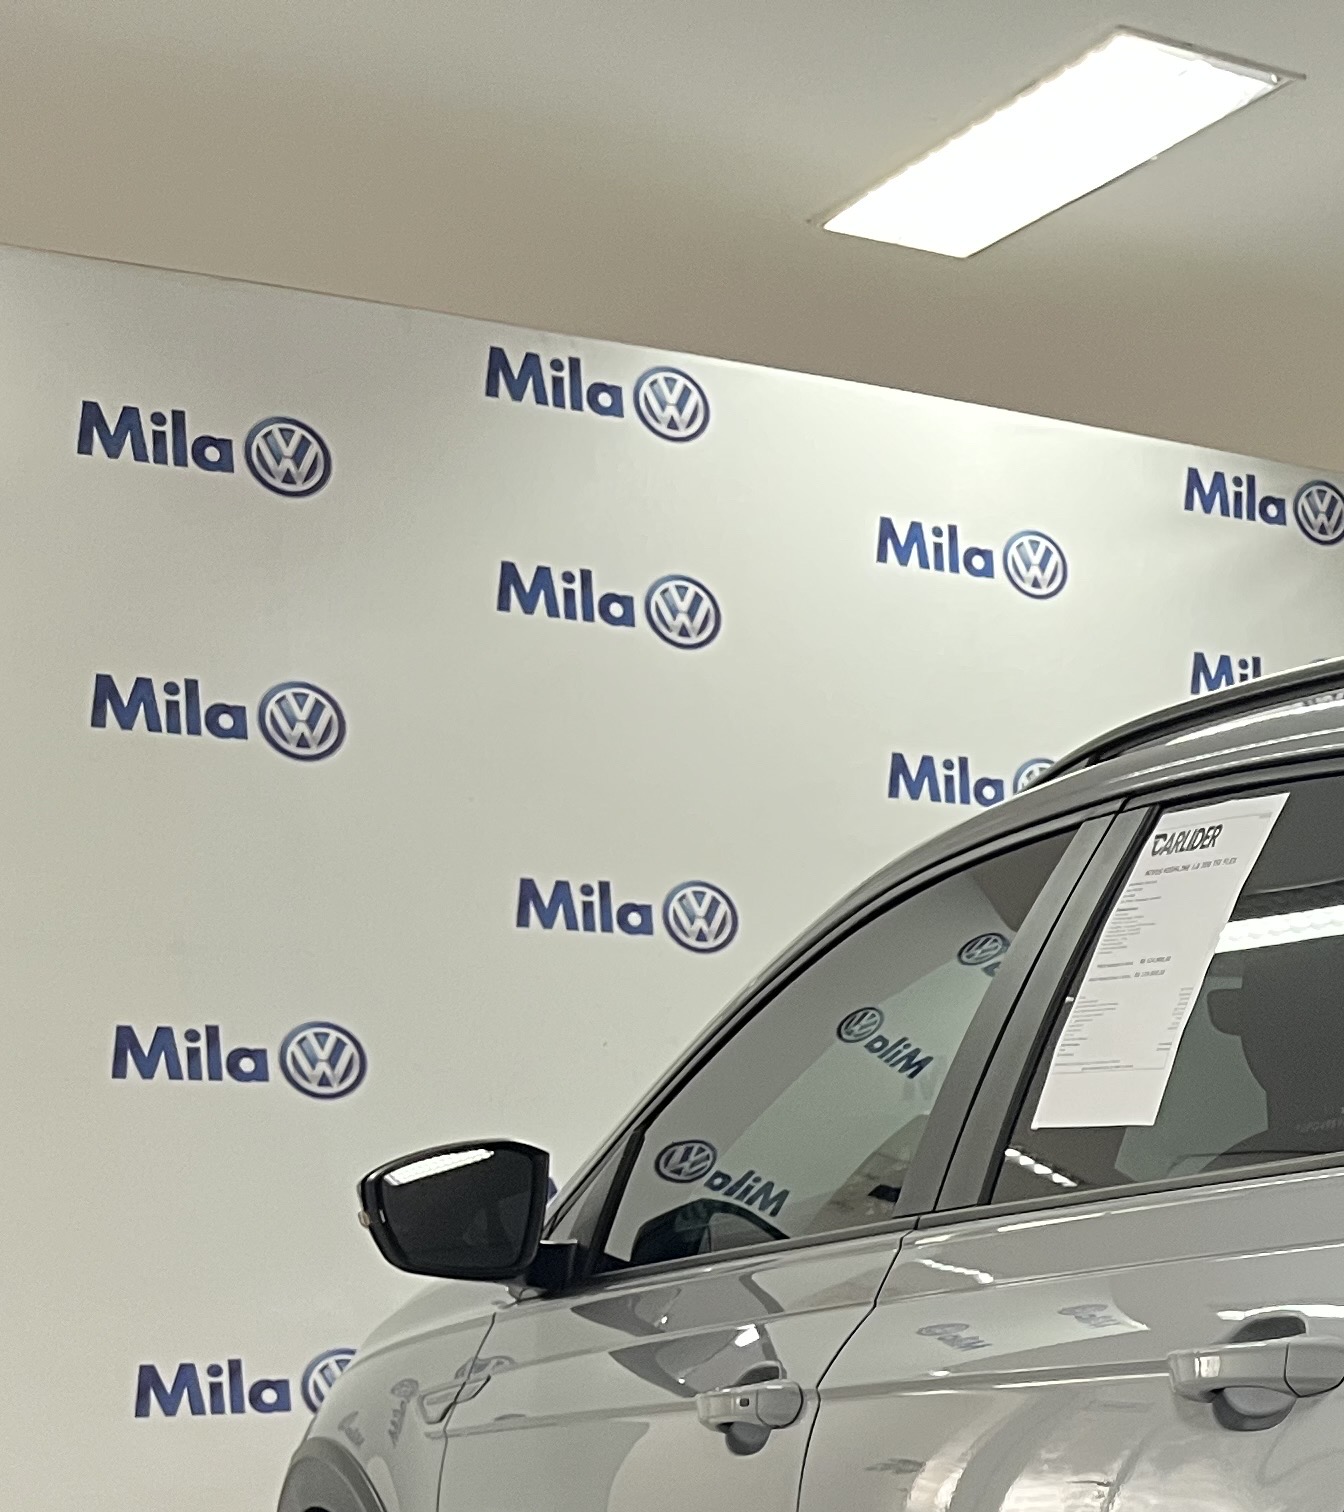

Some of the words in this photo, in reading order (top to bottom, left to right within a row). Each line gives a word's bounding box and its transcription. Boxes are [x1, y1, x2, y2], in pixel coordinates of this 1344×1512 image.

[485, 346, 624, 418] Mila
[76, 400, 234, 474] Mila
[1184, 467, 1286, 526] Mila
[876, 516, 995, 579] Mila
[497, 560, 636, 627] Mila
[1190, 651, 1262, 695] Mi
[91, 673, 248, 740] Mila
[888, 752, 1005, 807] Mila
[1151, 824, 1223, 857] CARLIDER
[516, 877, 654, 936] Mila
[111, 1024, 269, 1082] Mila
[135, 1358, 292, 1418] Mila
